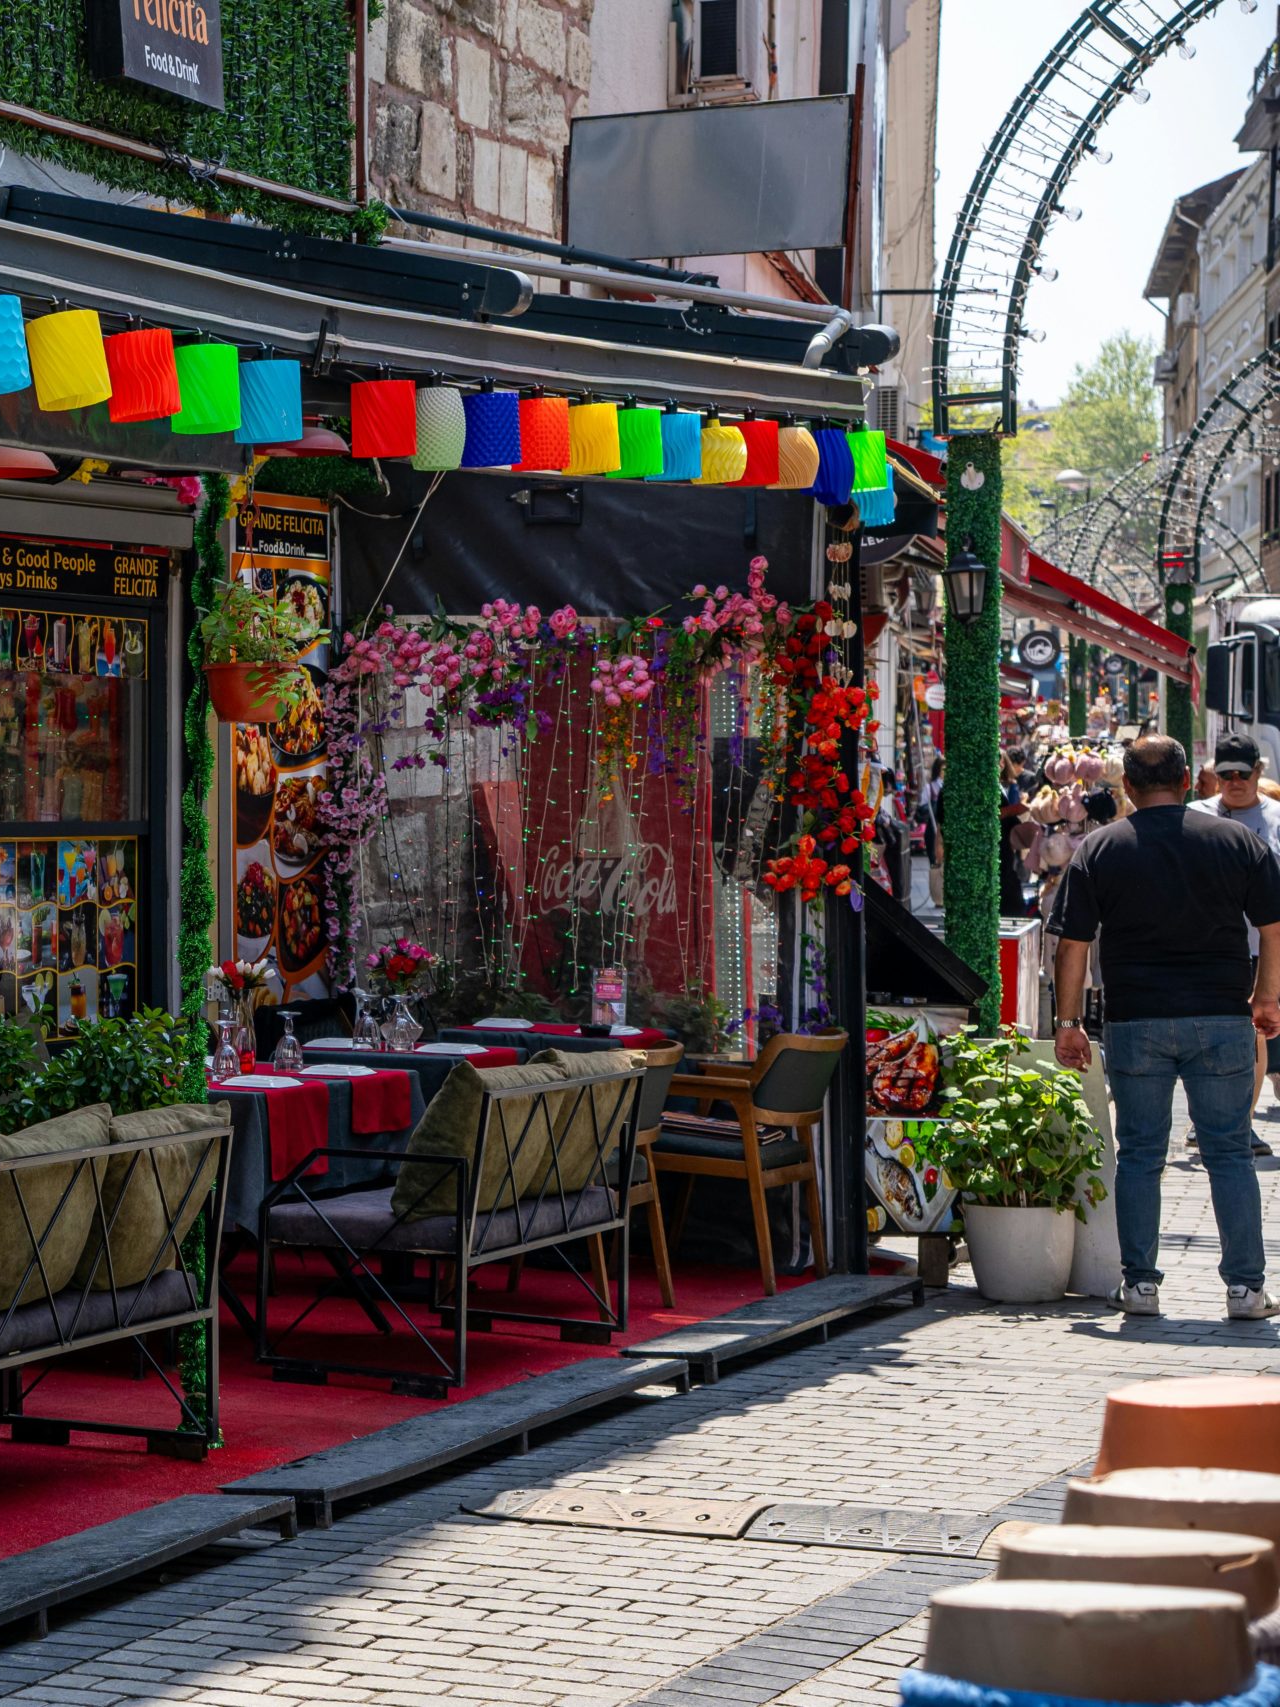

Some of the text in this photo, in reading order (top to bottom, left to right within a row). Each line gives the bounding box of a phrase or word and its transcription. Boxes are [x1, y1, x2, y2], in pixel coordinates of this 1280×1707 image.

[283, 515, 325, 536] FELICITA
[2, 547, 13, 566] &
[16, 548, 50, 570] Good
[54, 552, 97, 576] People
[113, 556, 159, 577] GRANDE
[16, 569, 58, 591] Drinks
[113, 577, 158, 598] FELICITA
[539, 843, 677, 917] Coca-Cola
